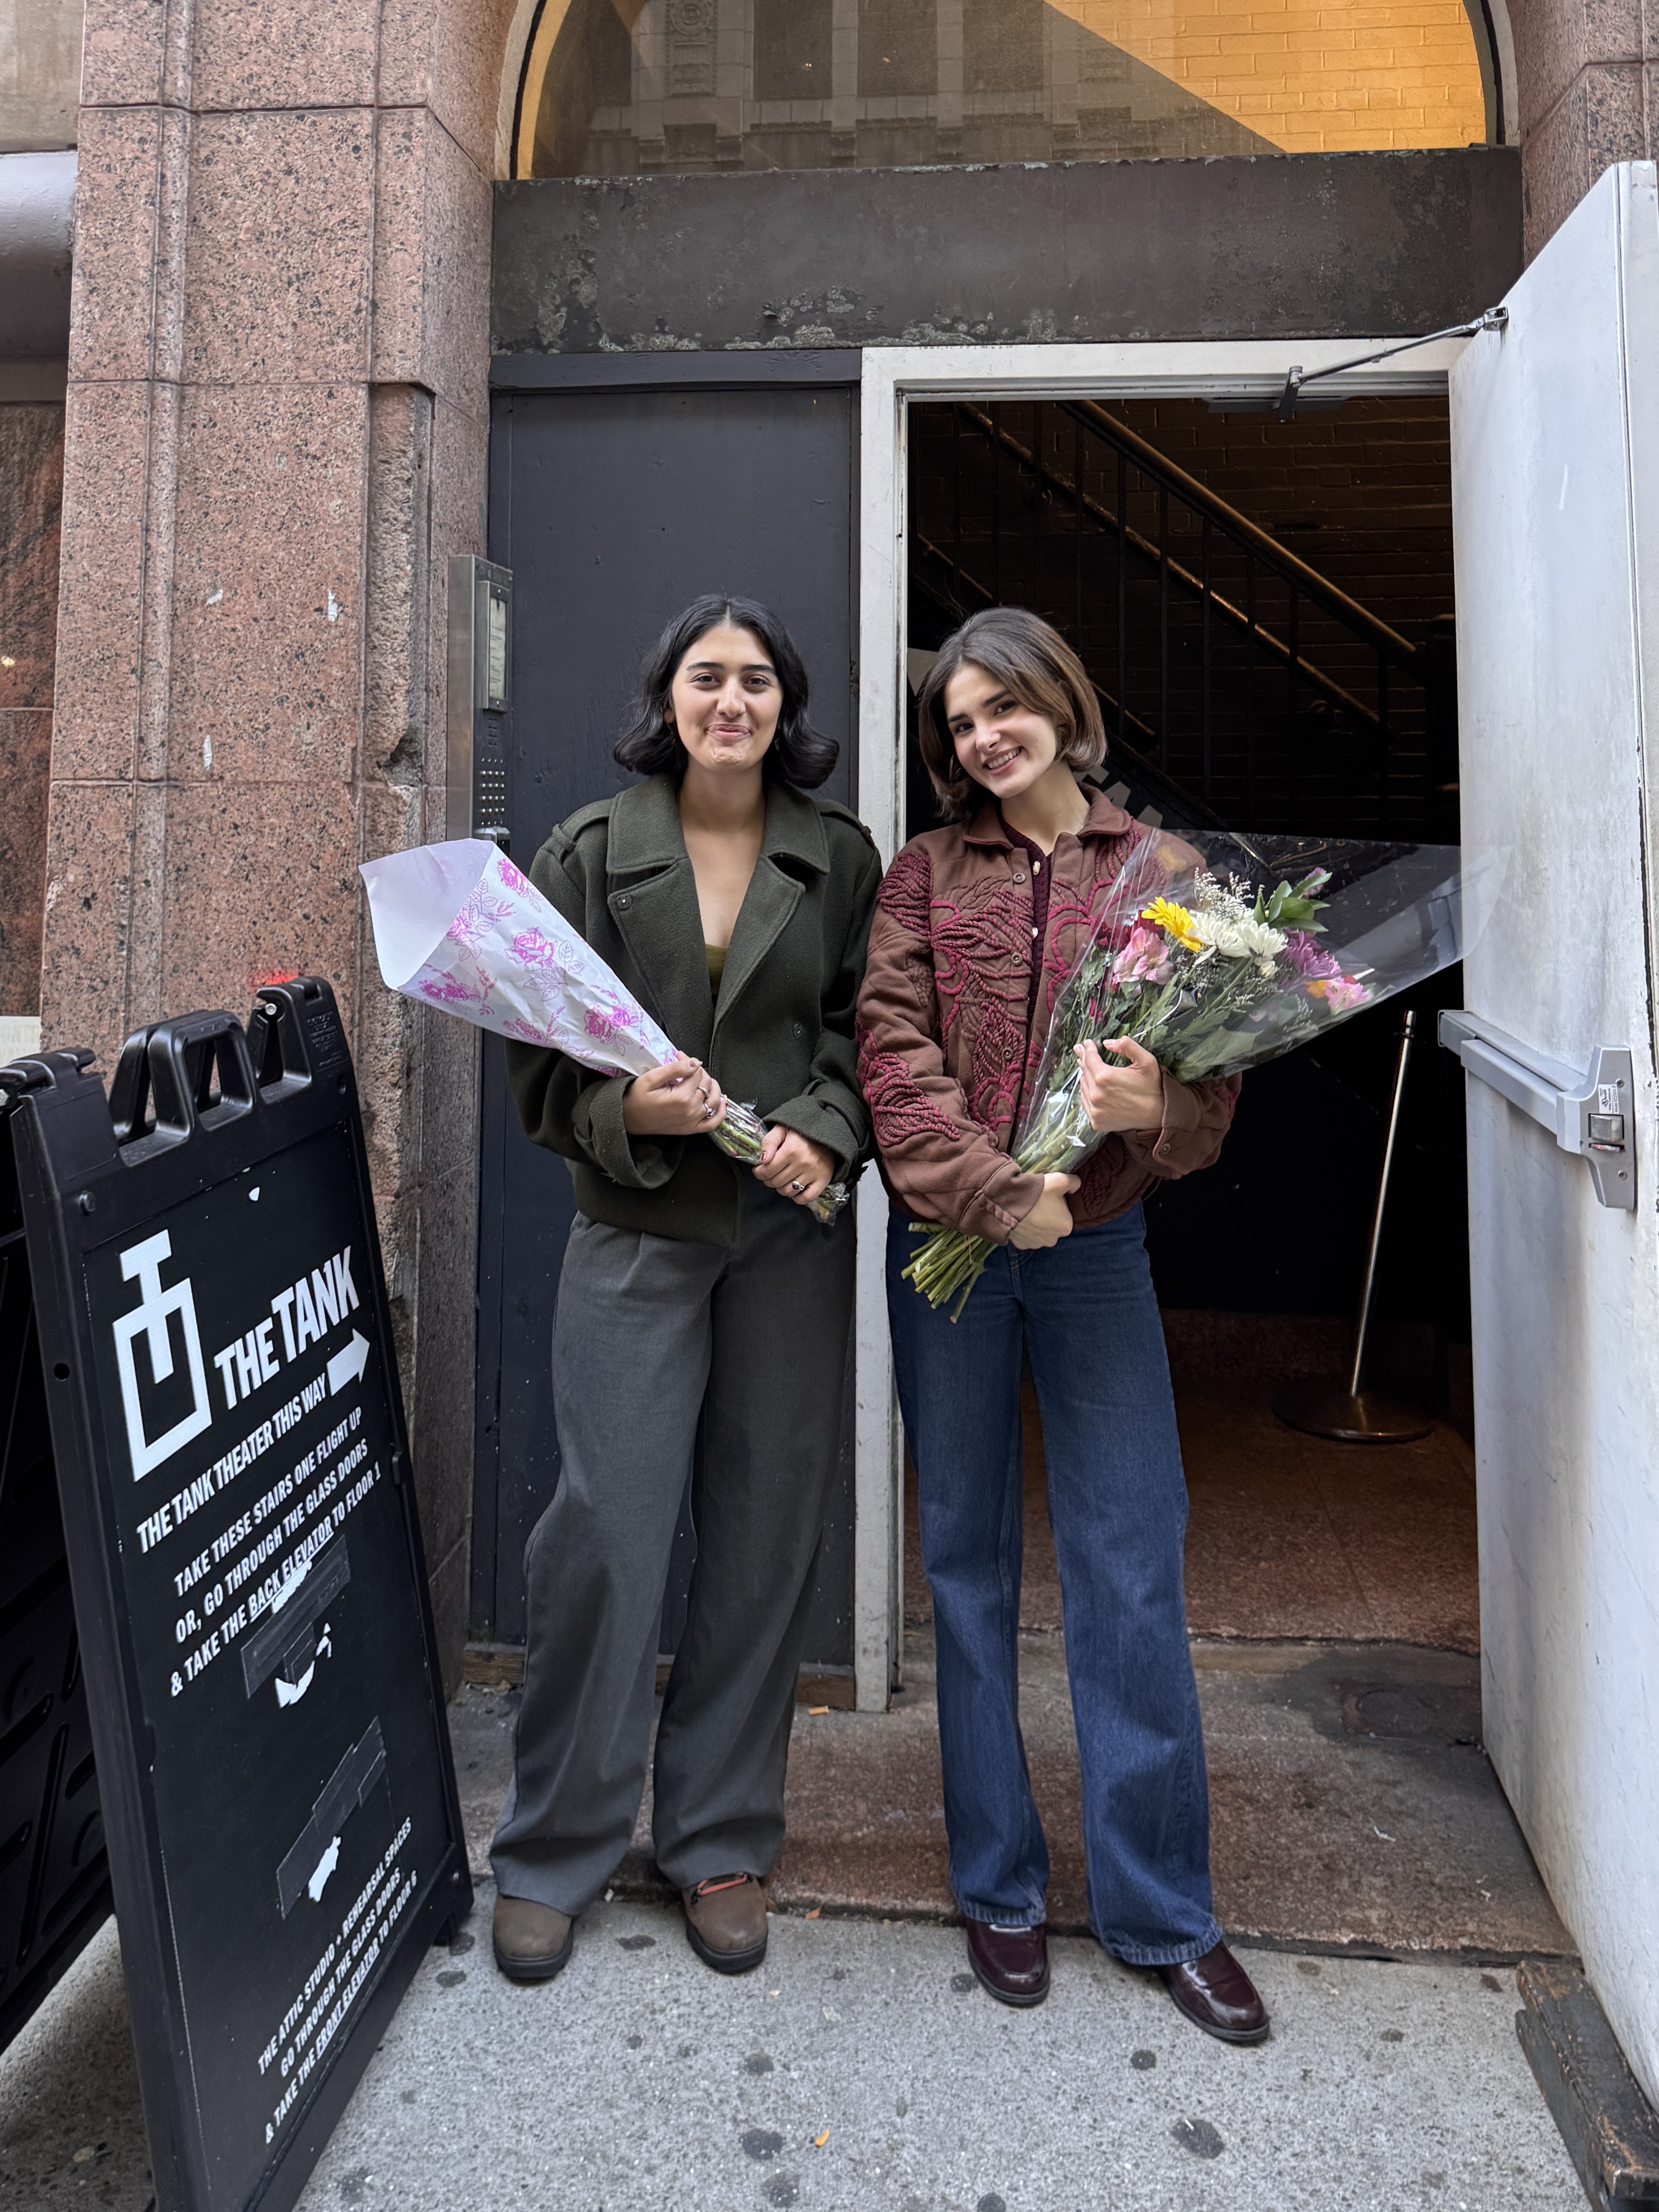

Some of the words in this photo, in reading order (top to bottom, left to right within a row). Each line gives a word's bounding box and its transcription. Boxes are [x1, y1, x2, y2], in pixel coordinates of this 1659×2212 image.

[214, 1317, 279, 1409] THE
[271, 1245, 359, 1363] TANK
[137, 1503, 173, 1553] THE
[171, 1469, 215, 1524] TANK
[213, 1421, 274, 1489] THEATER
[272, 1396, 301, 1438] THIS
[301, 1373, 326, 1413] WAY
[174, 1549, 211, 1596] TAKE
[211, 1511, 252, 1562] THESE
[254, 1474, 293, 1524] STAIRS
[295, 1451, 316, 1484] ONE
[317, 1419, 348, 1463] FLIGHT
[349, 1406, 361, 1430] UP
[176, 1610, 201, 1643] OR,
[204, 1584, 223, 1615] GO
[225, 1525, 282, 1594] THROUGH
[283, 1503, 305, 1536] THE
[306, 1470, 337, 1514] GLASS
[338, 1439, 367, 1481] DOORS
[171, 1672, 183, 1696] &
[184, 1631, 220, 1680] TAKE
[221, 1604, 247, 1643] THE
[248, 1569, 281, 1618] BACK
[281, 1516, 333, 1583] ELEVATOR
[332, 1502, 345, 1526] TO
[346, 1470, 373, 1512] FLOOR
[375, 1461, 381, 1480] 1
[258, 2035, 278, 2075] THE
[279, 1994, 304, 2045] ATTIC
[305, 1943, 335, 2001] STUDIO
[342, 1862, 385, 1938] REHEARSAL
[385, 1817, 411, 1867] SPACES
[265, 2123, 274, 2144] &
[274, 2078, 298, 2127] TAKE
[298, 2048, 316, 2085] THE
[316, 2000, 341, 2056] FRONT
[342, 1938, 379, 2009] ELEVATOR
[378, 1920, 388, 1943] TO
[389, 1881, 411, 1926] FLOOR
[281, 2047, 295, 2077] GO
[295, 1977, 335, 2053] THROUGH
[335, 1949, 352, 1984] THE
[352, 1909, 376, 1956] GLASS
[376, 1867, 400, 1916] DOORS
